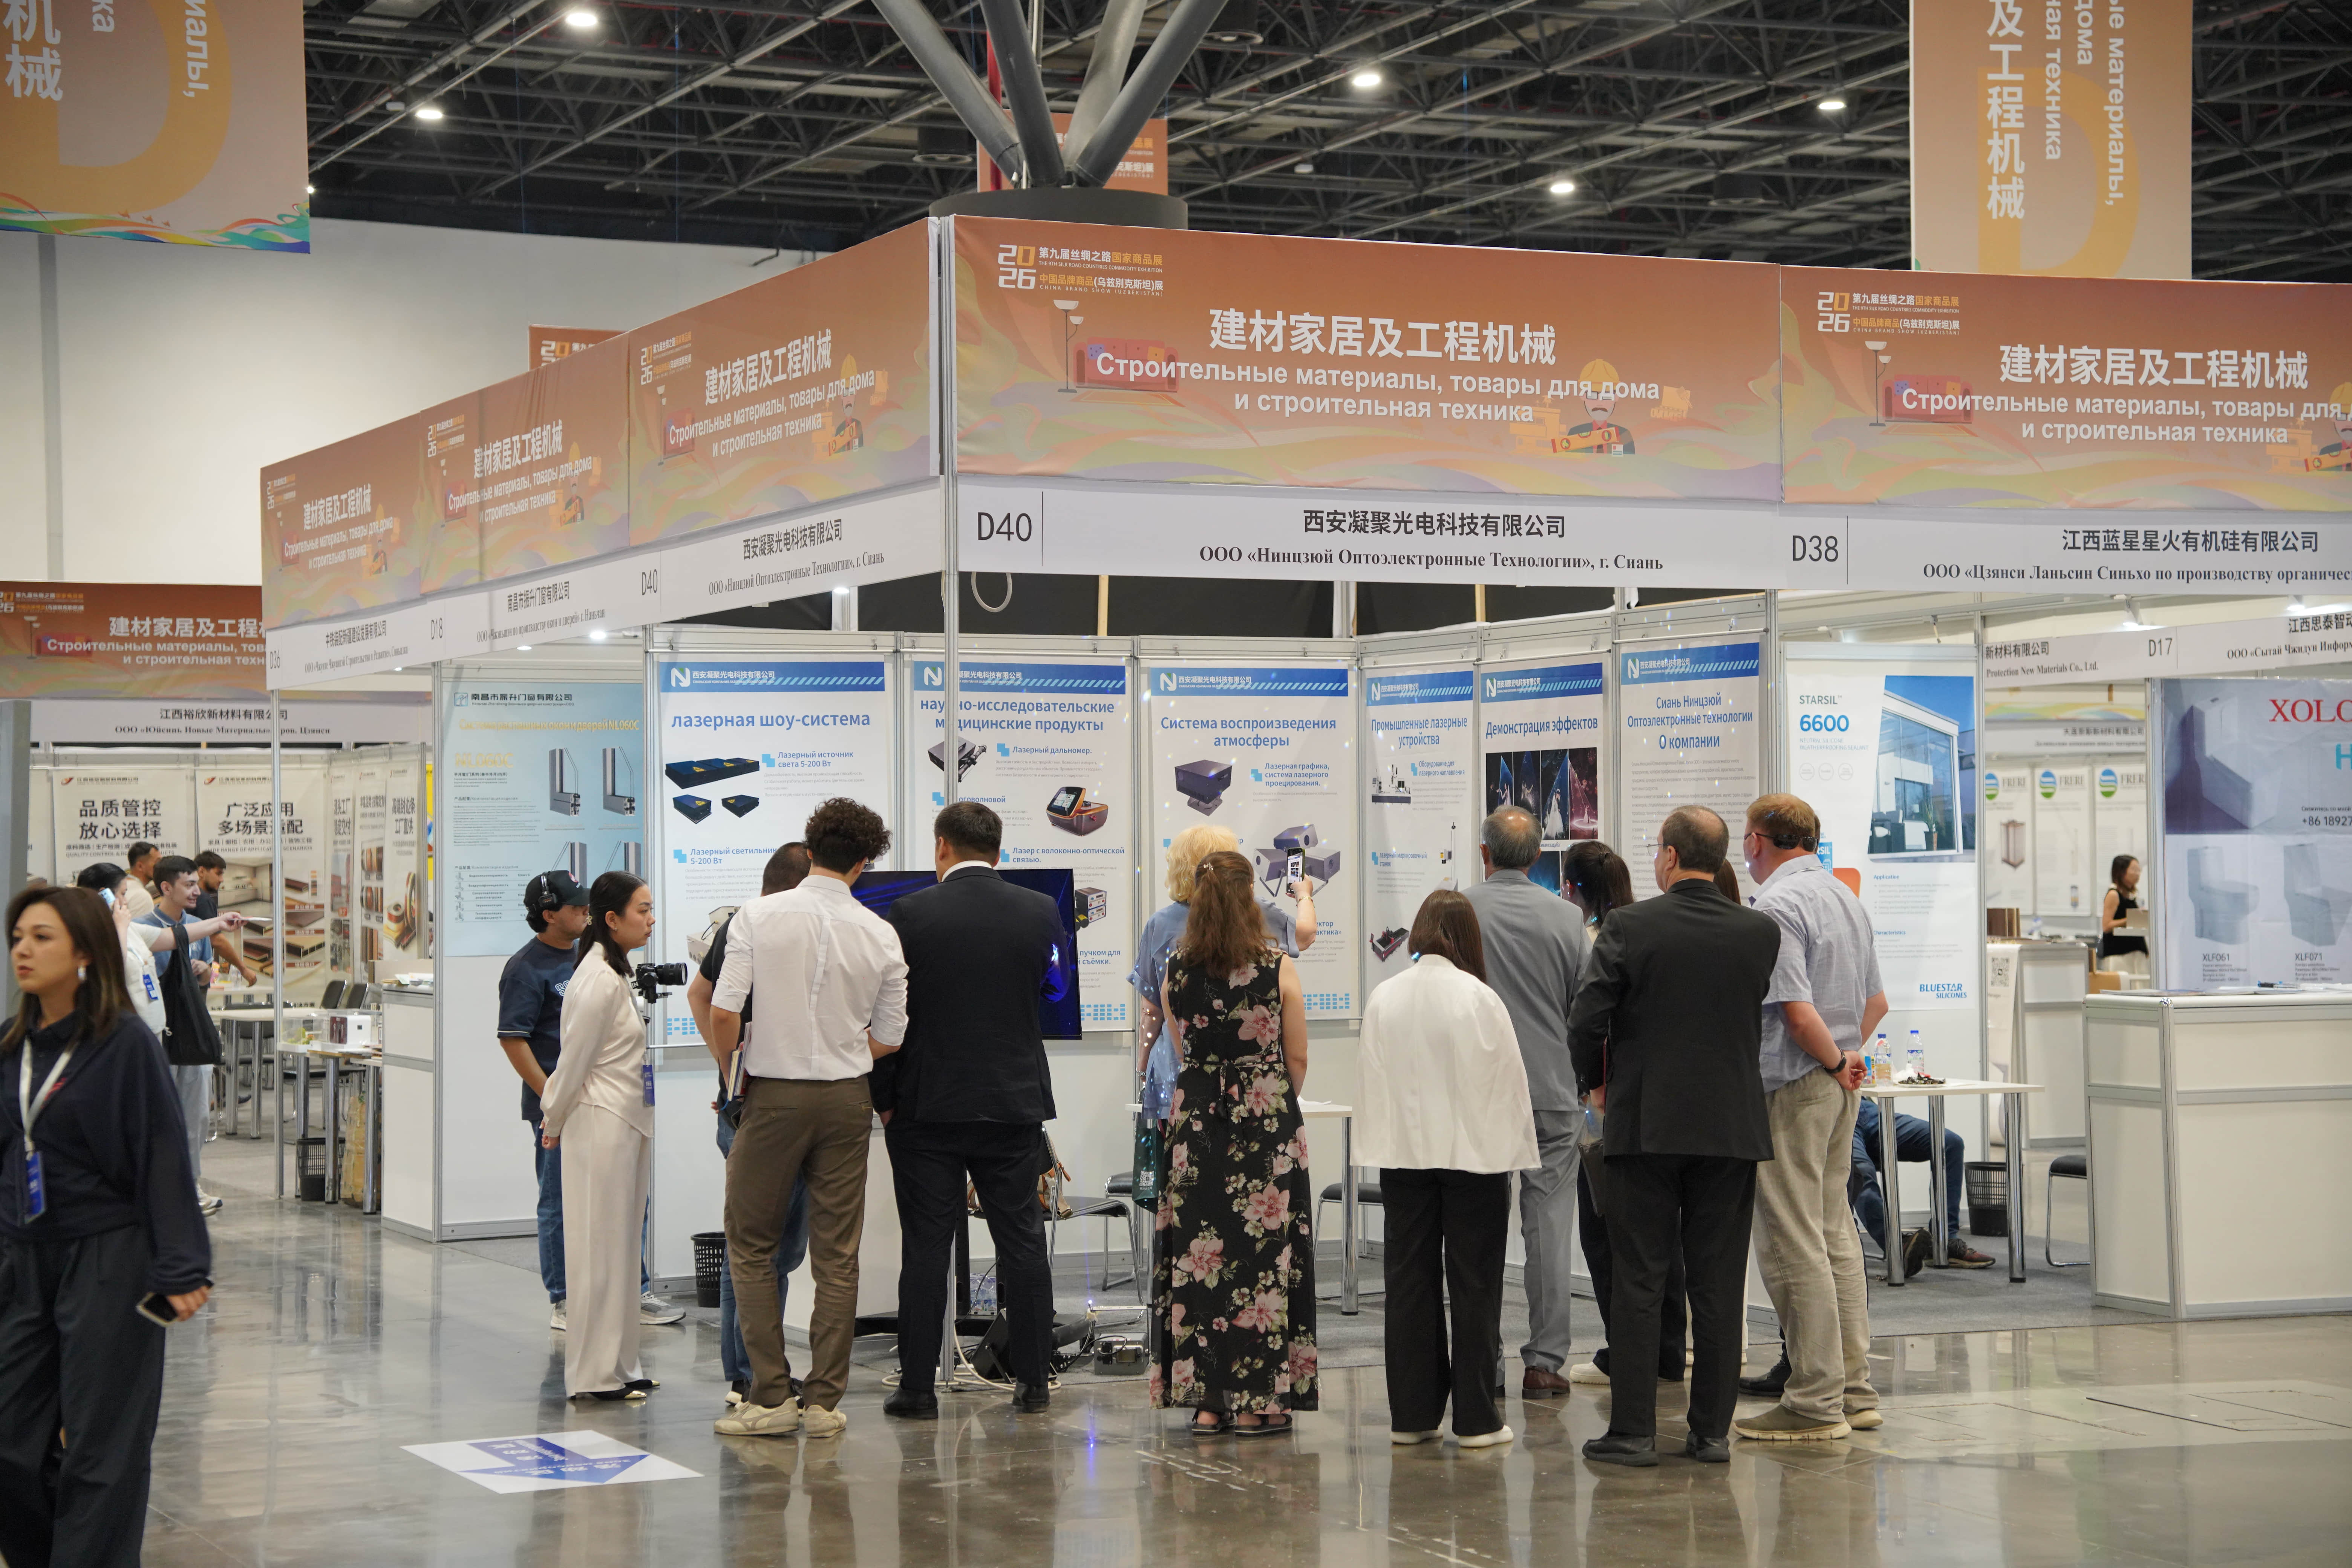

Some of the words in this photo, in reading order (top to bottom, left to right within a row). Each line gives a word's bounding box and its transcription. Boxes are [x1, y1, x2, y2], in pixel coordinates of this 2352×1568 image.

[2074, 0, 2093, 65] дома
[1987, 0, 2025, 219] 及工程机械
[2046, 48, 2061, 160] техника
[2104, 39, 2124, 205] материалы,
[998, 244, 1036, 266] 20
[1039, 247, 1163, 265] 第九届丝绸之路国家商品展
[998, 268, 1037, 289] 26
[1818, 292, 1850, 311] 20
[1818, 313, 1850, 332] 26
[1209, 308, 1557, 365] 建材家居及工程机械
[705, 328, 831, 406] 建材家居及工程机械
[2000, 344, 2309, 389] 建材家居及工程机械
[1096, 352, 1288, 384] Строительные
[1297, 367, 1442, 395] материалы,
[1450, 375, 1540, 403] товары
[1548, 379, 1592, 398] для
[1599, 381, 1660, 401] дома
[669, 413, 731, 447] Строительные
[733, 396, 787, 428] материалы,
[789, 384, 825, 409] товары
[827, 378, 846, 401] для
[848, 370, 874, 397] дома
[1235, 393, 1249, 410] и
[1257, 393, 1431, 418] строительная
[1439, 402, 1534, 422] техника
[1902, 388, 2068, 414] Строительные
[2076, 397, 2205, 419] материалы,
[2212, 401, 2294, 421] товары
[2300, 402, 2341, 421] для
[720, 423, 782, 458] строительная
[785, 413, 822, 436] техника
[2022, 423, 2034, 438] и
[2042, 423, 2196, 444] строительная
[2202, 426, 2288, 443] техника
[474, 419, 563, 479] 建材家居及工程机械
[303, 483, 371, 530] 建材家居及工程机械
[978, 512, 1032, 542] D40
[1303, 509, 1565, 538] 西安凝聚光电科技有限公司
[743, 519, 842, 561] 西安凝聚光电科技有限公司
[1792, 535, 1839, 562] D38
[2062, 529, 2319, 553] 江西蓝星星火有机硅有限公司
[1200, 546, 1242, 562] ООО
[1248, 547, 1333, 565] «Нинцзюй
[1338, 549, 1485, 569] Оптоэлектронные
[1490, 552, 1595, 572] Технологии»,
[1600, 558, 1609, 570] г.
[1614, 554, 1663, 570] Сиань
[642, 569, 658, 596] D40
[709, 582, 723, 596] ООО
[724, 574, 754, 592] «Нинцзюй
[756, 562, 810, 587] Оптоэлектронные
[812, 558, 854, 576] Технологии»,
[863, 551, 884, 566] Сиань
[1923, 564, 1960, 579] ООО
[1964, 564, 2025, 582] «Цзянси
[2029, 565, 2093, 581] Ланьсин
[2097, 565, 2151, 581] Синьхо
[2154, 570, 2172, 581] по
[2176, 569, 2273, 584] производству
[507, 581, 570, 612] 南昌市振升门窗有限公司
[431, 618, 443, 640] D18
[47, 639, 152, 654] Строительные
[157, 640, 237, 655] материалы,
[1985, 642, 2049, 660] 新材料有限公司
[2149, 638, 2173, 656] D17
[2227, 648, 2248, 659] ООО
[136, 655, 231, 666] строительная
[270, 650, 280, 669] D36
[1987, 667, 2019, 678] Protection
[2021, 666, 2035, 675] New
[2037, 663, 2068, 674] Materials
[2085, 661, 2099, 671] Ltd.
[920, 698, 1114, 715] науно-исследовательские
[1656, 695, 1681, 709] Сиань
[1683, 692, 1721, 709] Нинцзюй
[672, 715, 755, 730] лазерная
[760, 713, 870, 730] шоу-система
[935, 718, 1032, 731] мдицинские
[1035, 720, 1103, 733] продукты
[1161, 717, 1217, 729] Система
[1221, 718, 1336, 732] воспроизведения
[1372, 718, 1429, 734] Промышленные
[1430, 718, 1467, 731] лазерные
[1486, 720, 1550, 739] Демонстрация
[1551, 716, 1598, 734] эффектов
[1628, 714, 1701, 728] Оптоэлектронные
[1703, 712, 1753, 724] технологии
[1800, 715, 1850, 732] 6600
[1214, 735, 1289, 749] атмосферы
[1399, 732, 1439, 749] устройства
[1659, 735, 1666, 749] О
[1669, 735, 1720, 749] компании
[778, 751, 816, 760] Лазерный
[79, 798, 161, 818] 品质管控
[79, 821, 161, 840] 放心选择
[2202, 953, 2230, 962] XLF061
[2295, 952, 2323, 961] XLF071
[1920, 983, 1963, 992] BLUESTAR
